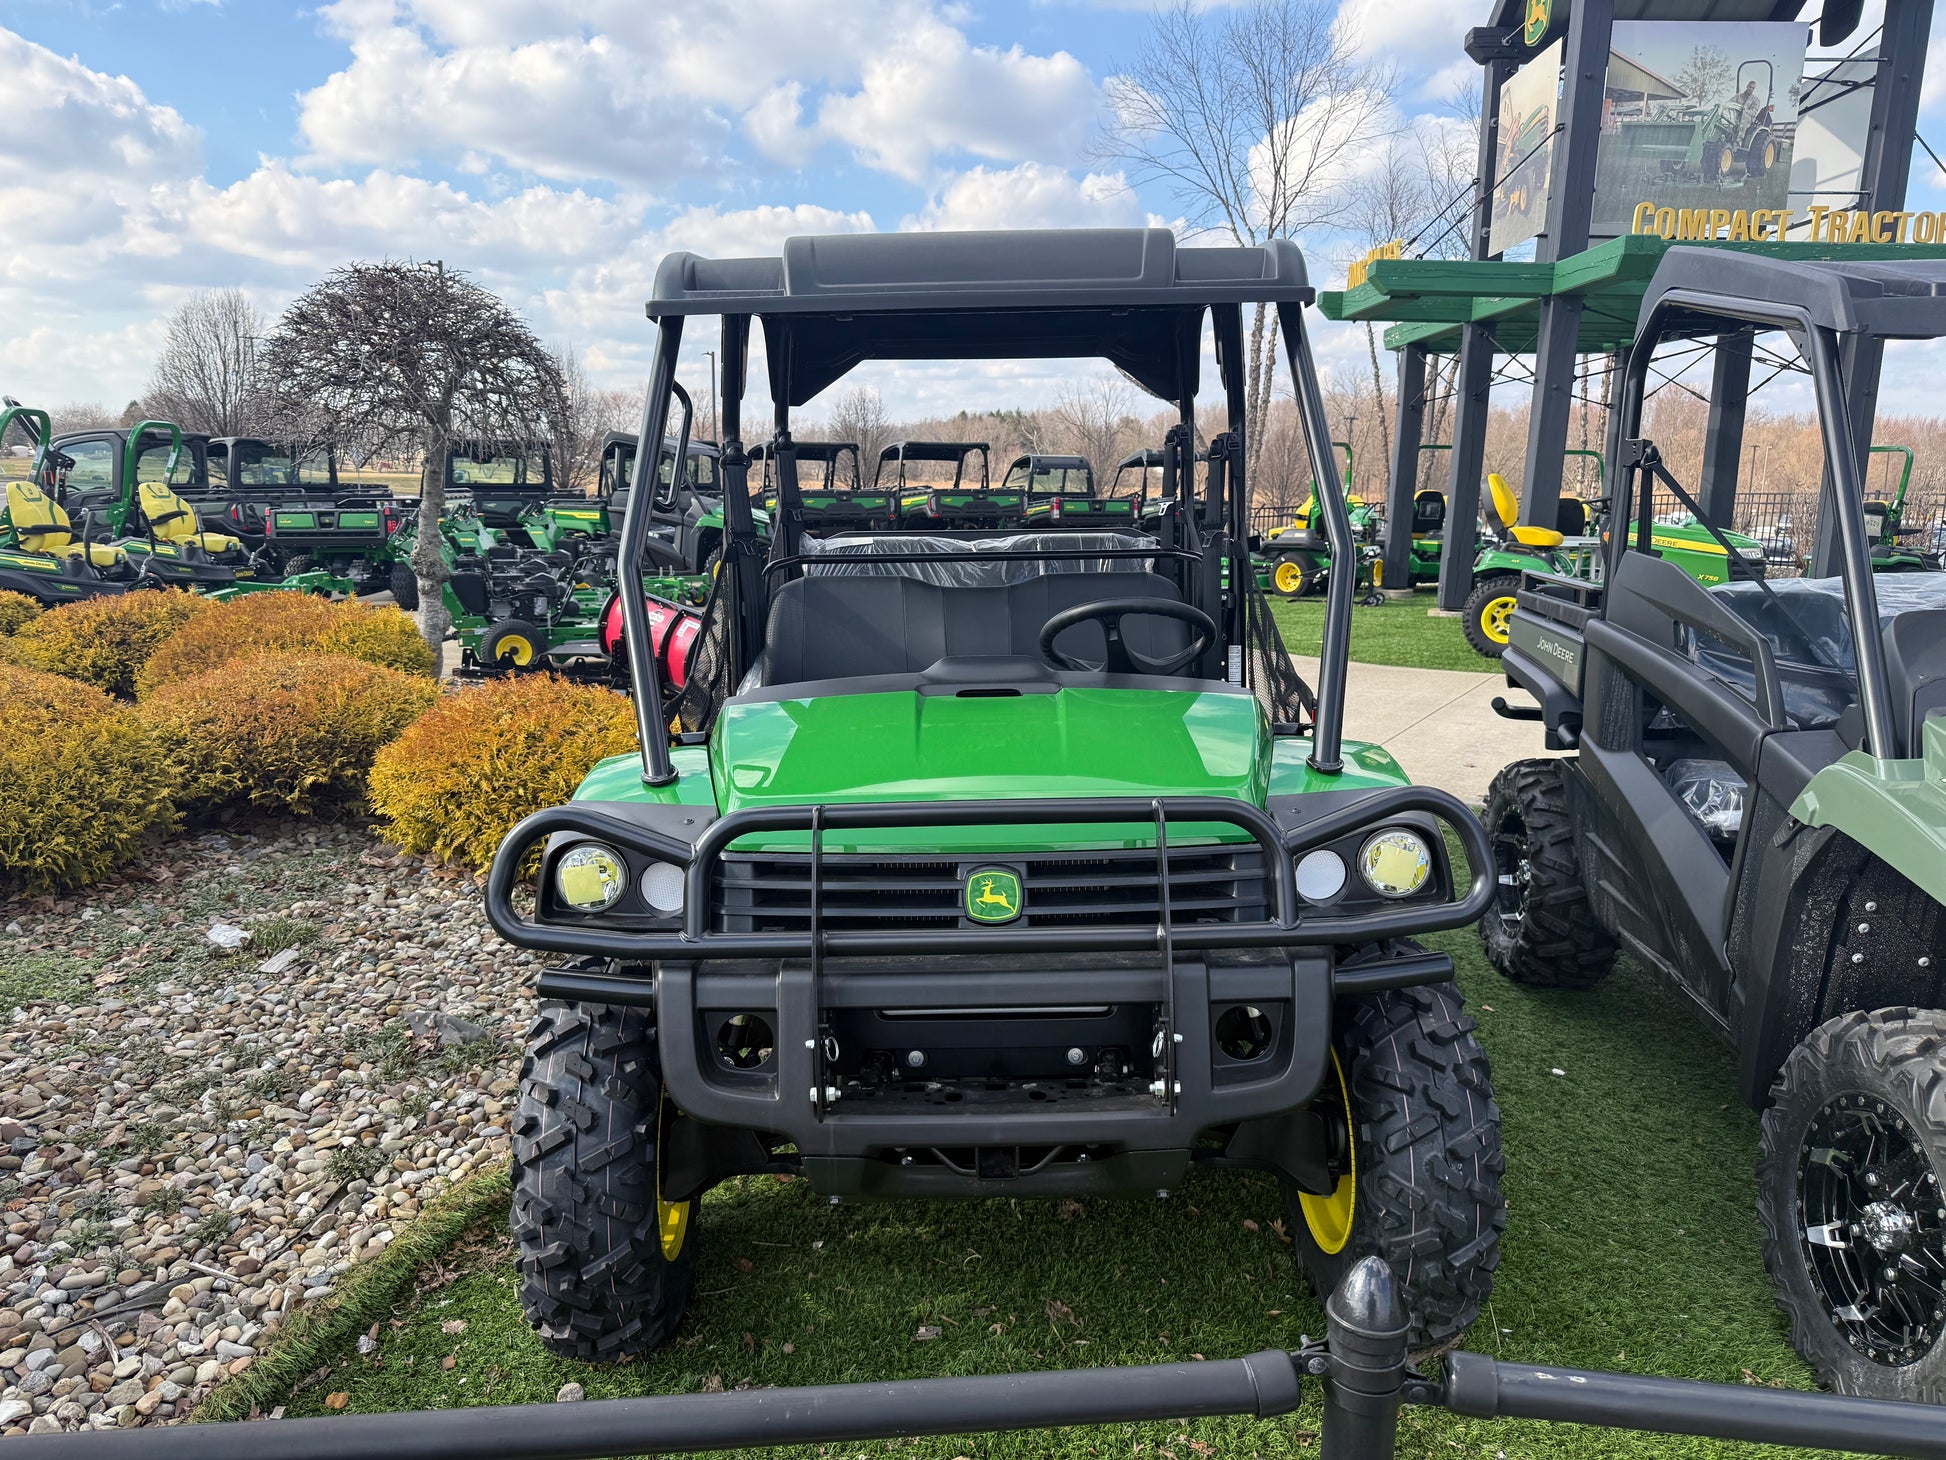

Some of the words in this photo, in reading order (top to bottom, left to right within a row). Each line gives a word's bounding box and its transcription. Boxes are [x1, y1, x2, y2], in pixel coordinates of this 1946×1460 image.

[1632, 201, 1793, 241] COMPACT
[1652, 537, 1678, 548] DEERE
[1537, 636, 1553, 654] JOHN
[1553, 643, 1574, 664] DEERE
